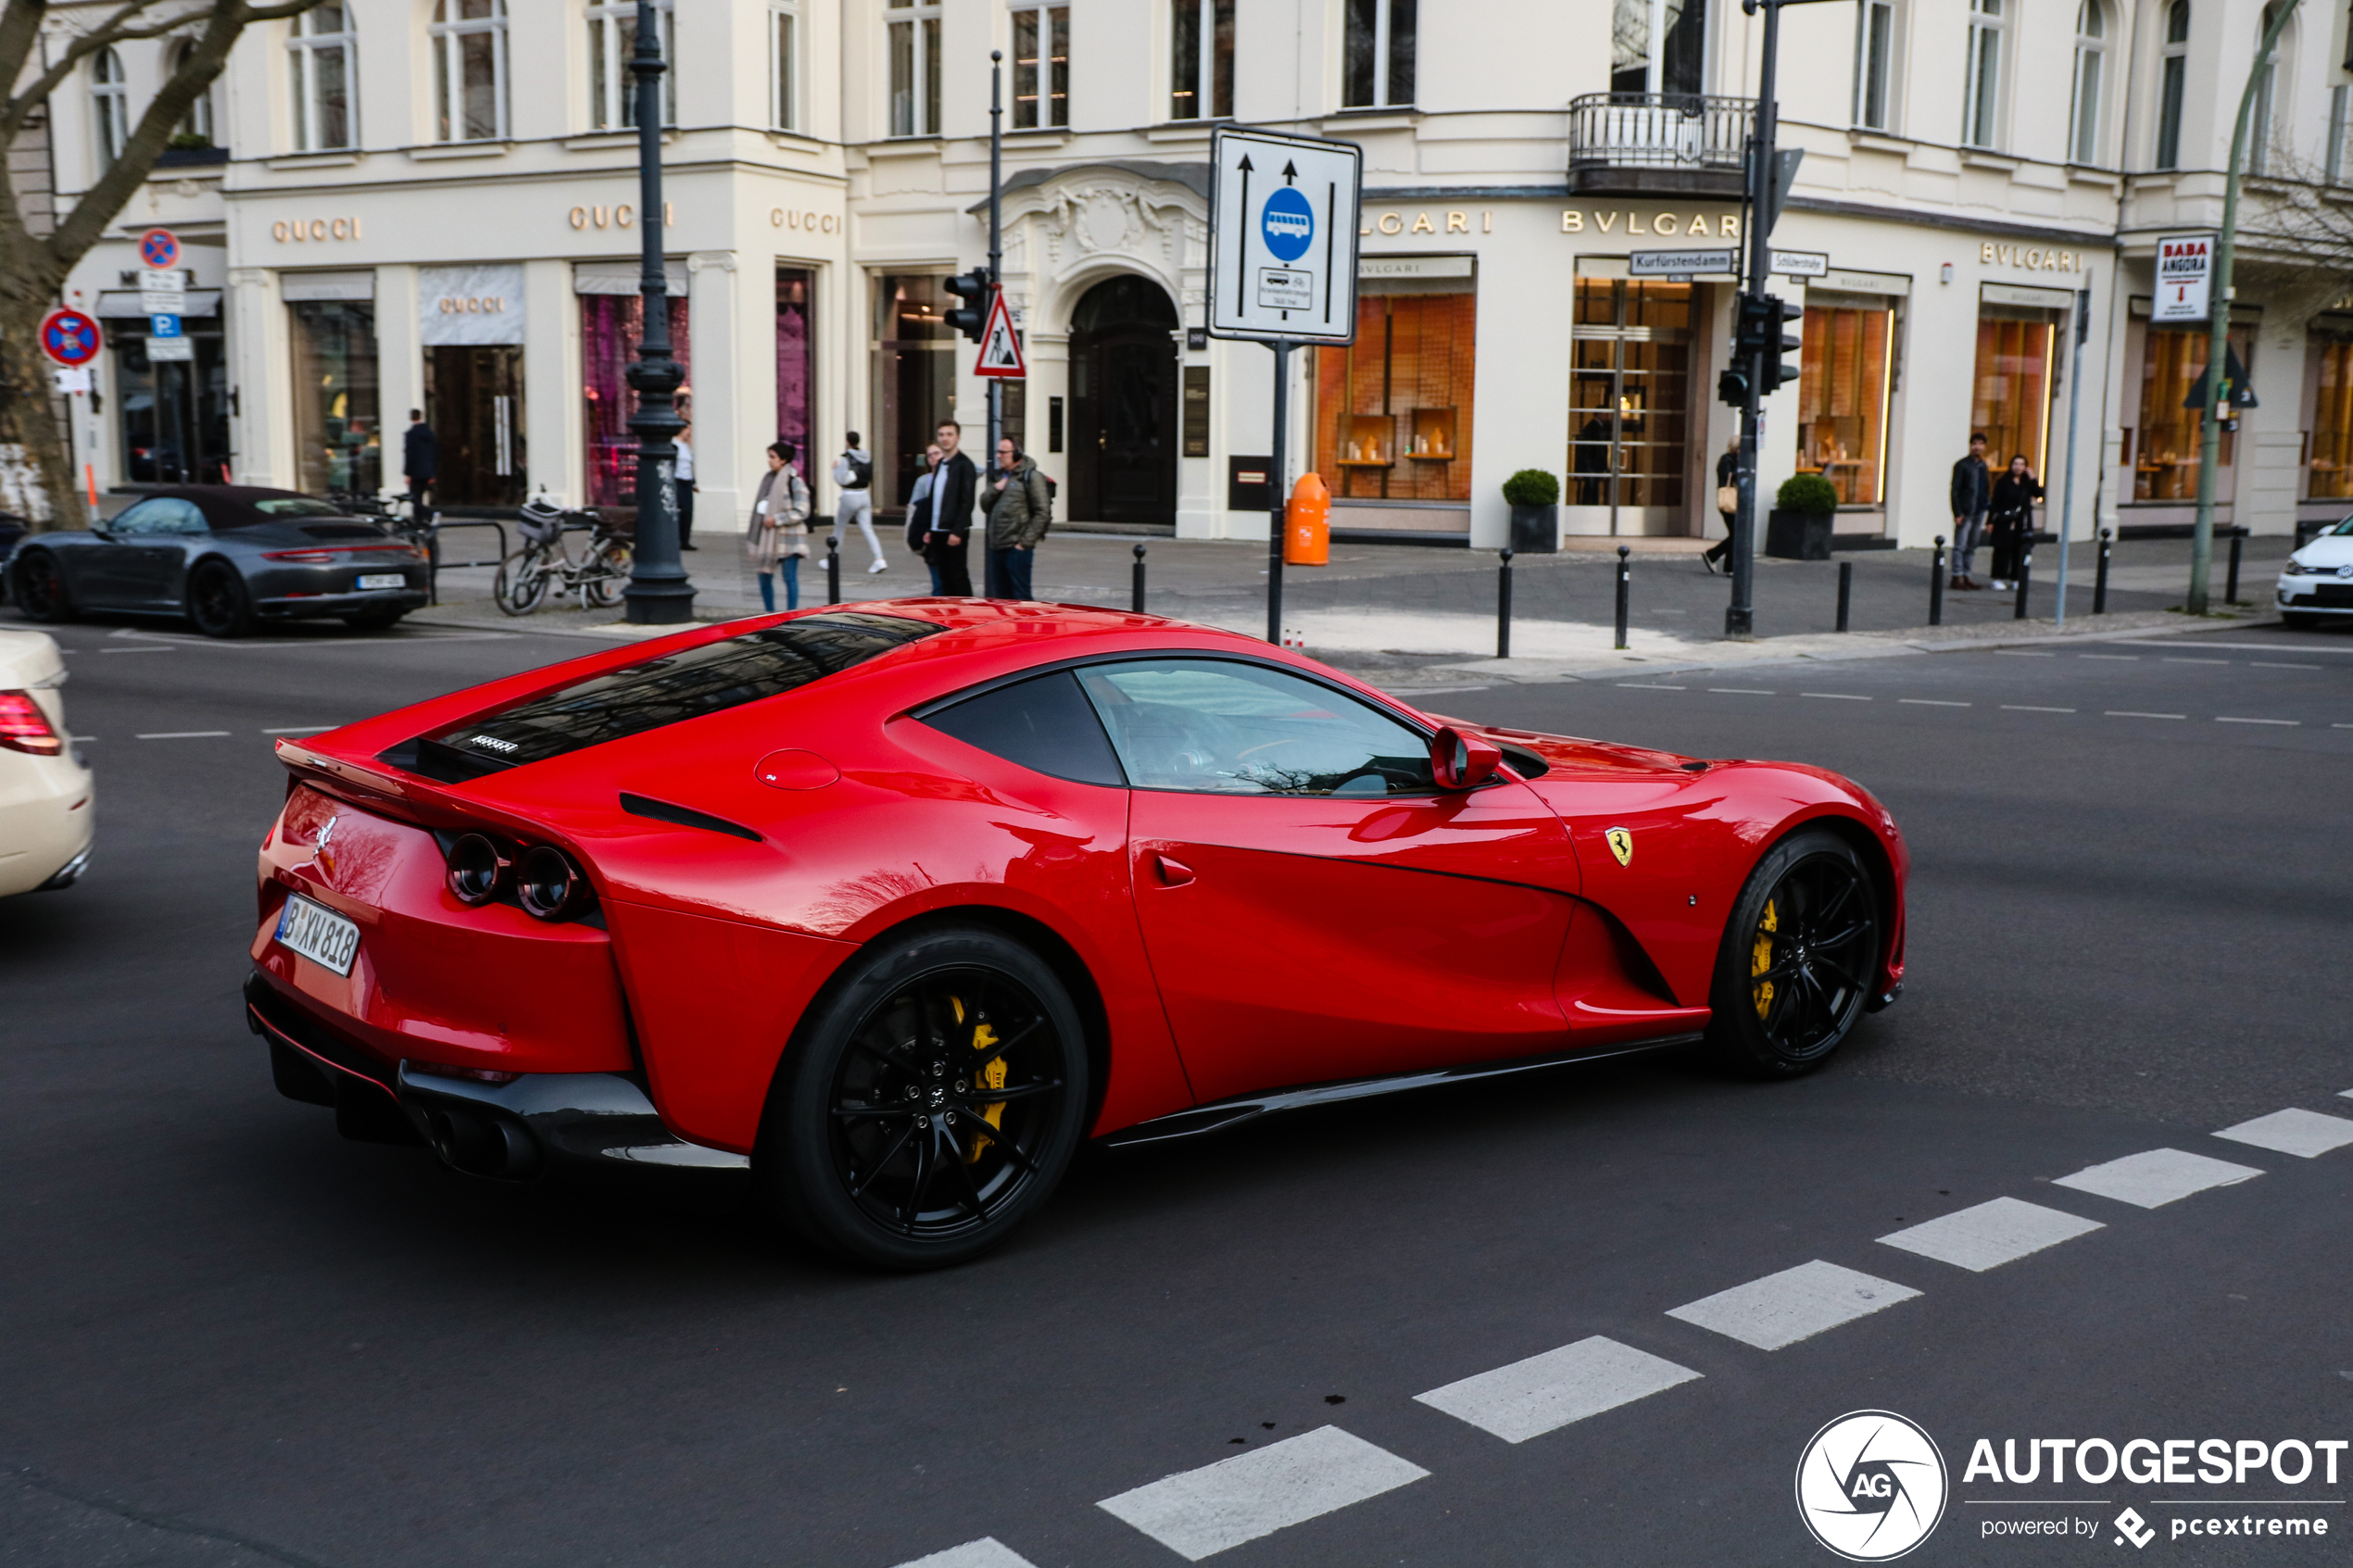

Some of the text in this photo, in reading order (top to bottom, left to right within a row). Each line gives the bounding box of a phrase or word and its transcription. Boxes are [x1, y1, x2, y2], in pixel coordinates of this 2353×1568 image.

[569, 202, 675, 230] GUCI
[771, 208, 841, 234] GUCCI
[1359, 211, 1492, 235] GARI
[1561, 210, 1739, 237] BVLGAR
[272, 217, 362, 245] GUCCI
[1635, 254, 1729, 269] Kurfürstendamm
[1980, 242, 2083, 272] BVLGARI
[2163, 243, 2207, 257] BABA
[2161, 258, 2207, 272] ANGORA
[438, 296, 506, 314] GUCCI
[283, 901, 356, 968] B XW 818
